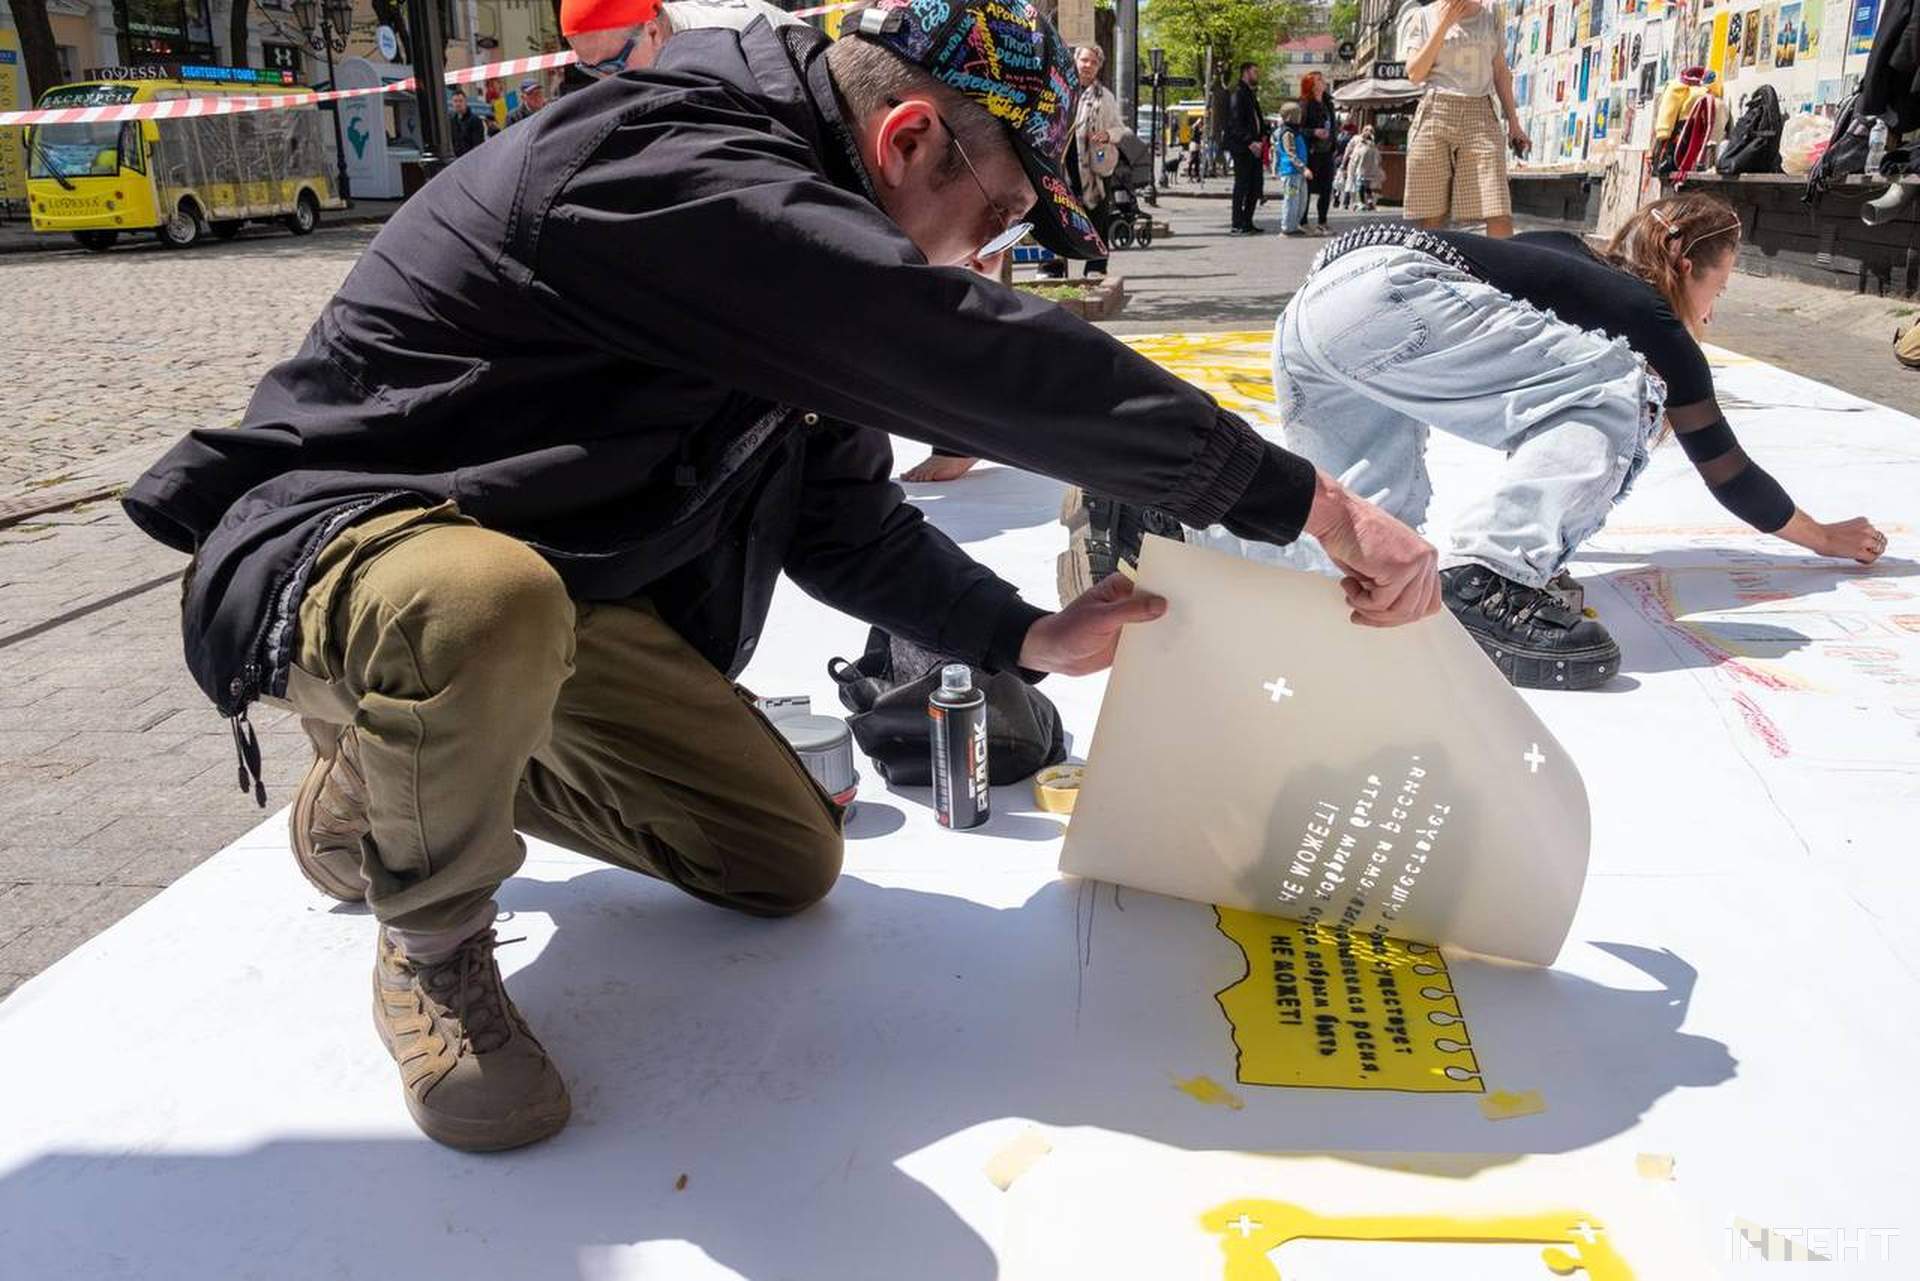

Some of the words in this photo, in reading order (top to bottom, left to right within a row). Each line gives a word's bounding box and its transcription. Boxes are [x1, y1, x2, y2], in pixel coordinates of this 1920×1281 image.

[976, 722, 989, 813] BLACK
[1271, 935, 1295, 956] НЕ
[1273, 960, 1303, 1025] МОЖЕТ!
